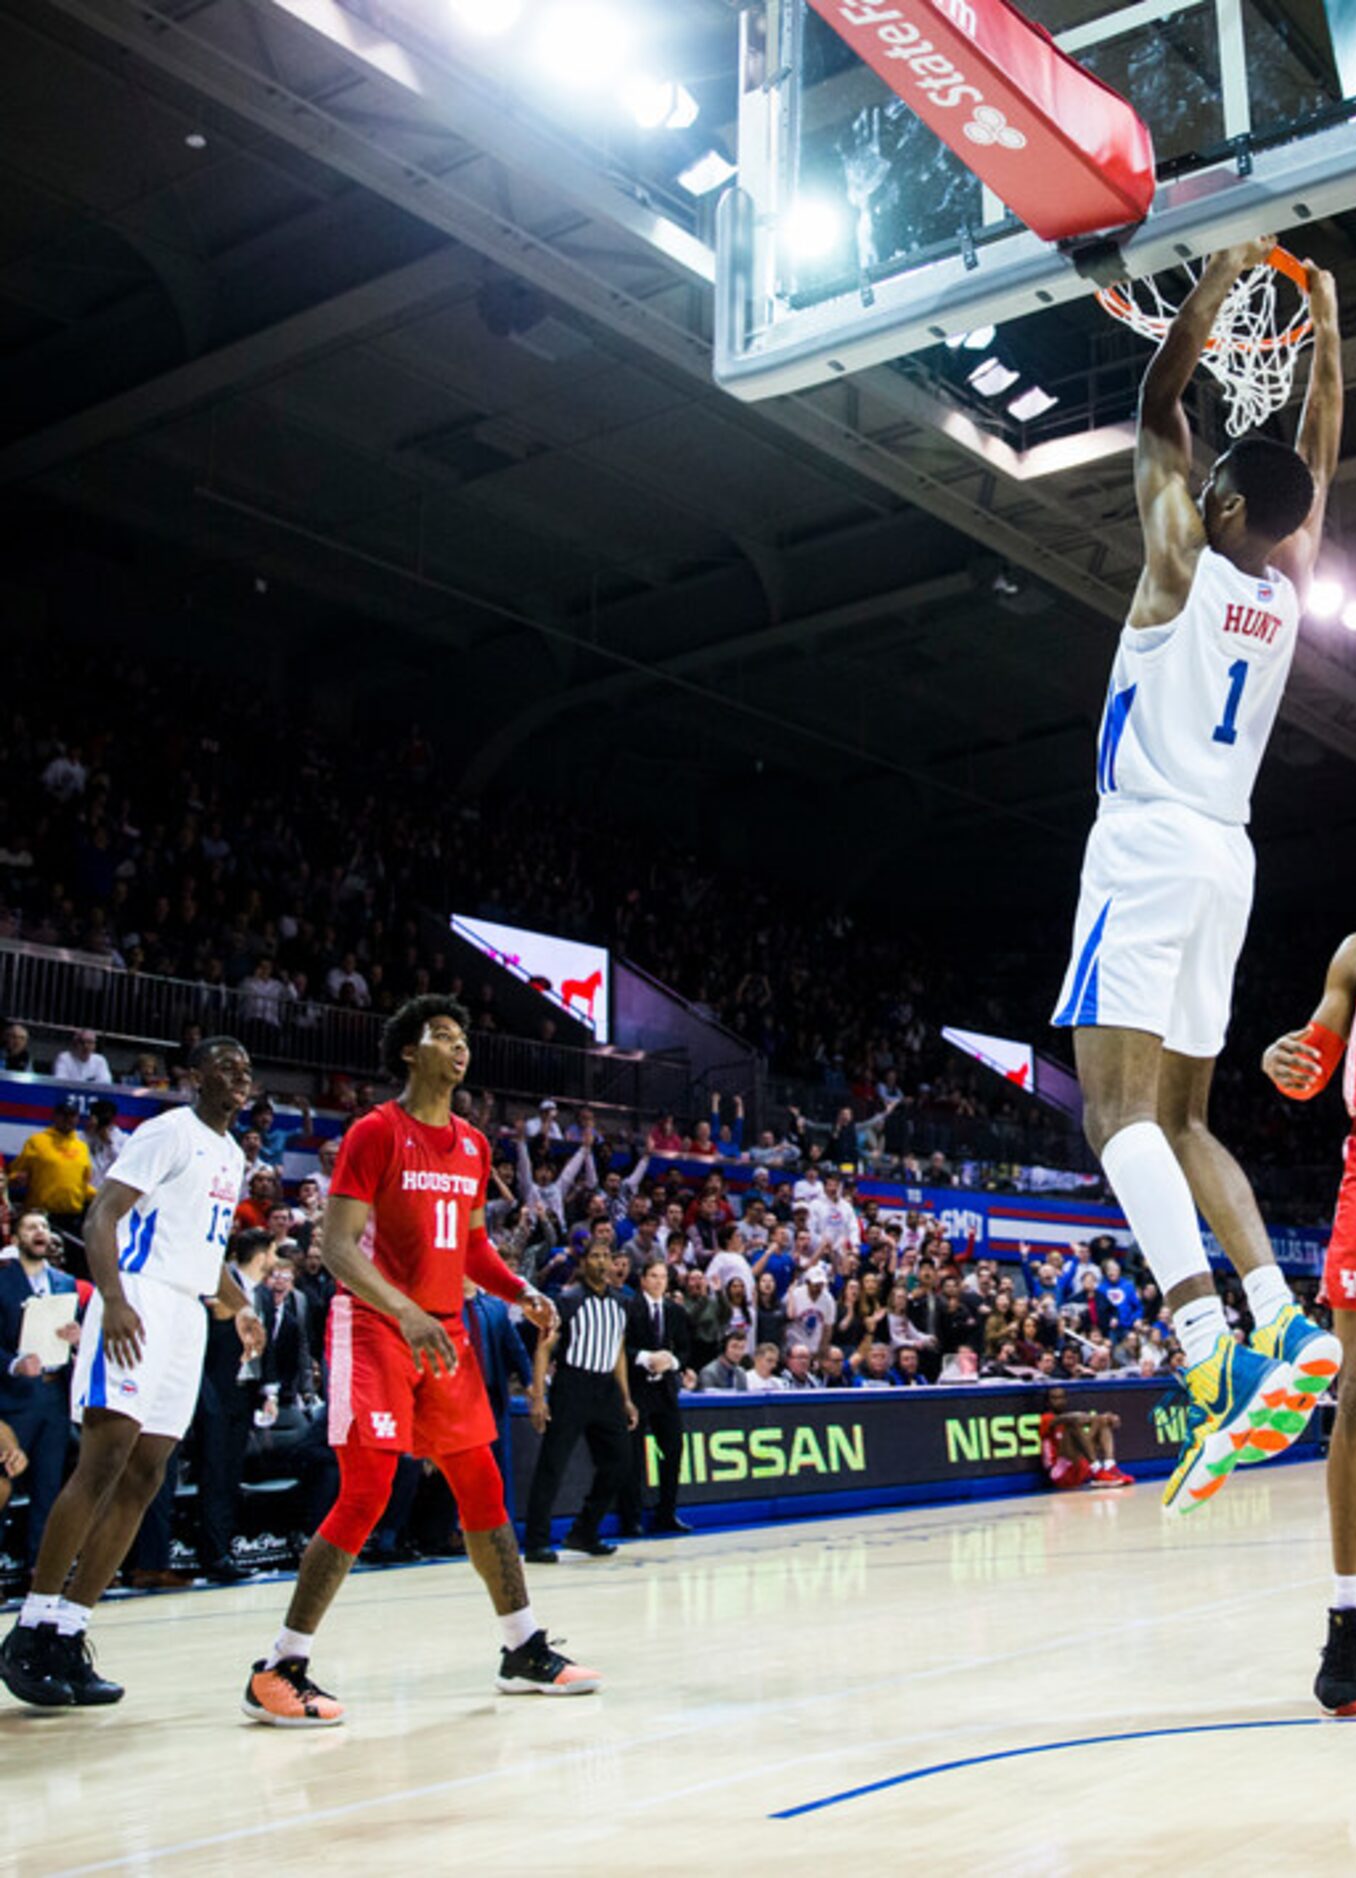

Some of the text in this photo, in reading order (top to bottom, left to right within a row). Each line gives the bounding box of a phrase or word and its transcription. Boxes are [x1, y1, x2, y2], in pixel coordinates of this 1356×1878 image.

[1223, 602, 1283, 645] HUNT
[1212, 658, 1249, 746] 1
[402, 1169, 479, 1197] HOUSTON
[433, 1198, 459, 1250] 11
[644, 1424, 866, 1487] NISSAN
[945, 1413, 1042, 1463] NISS
